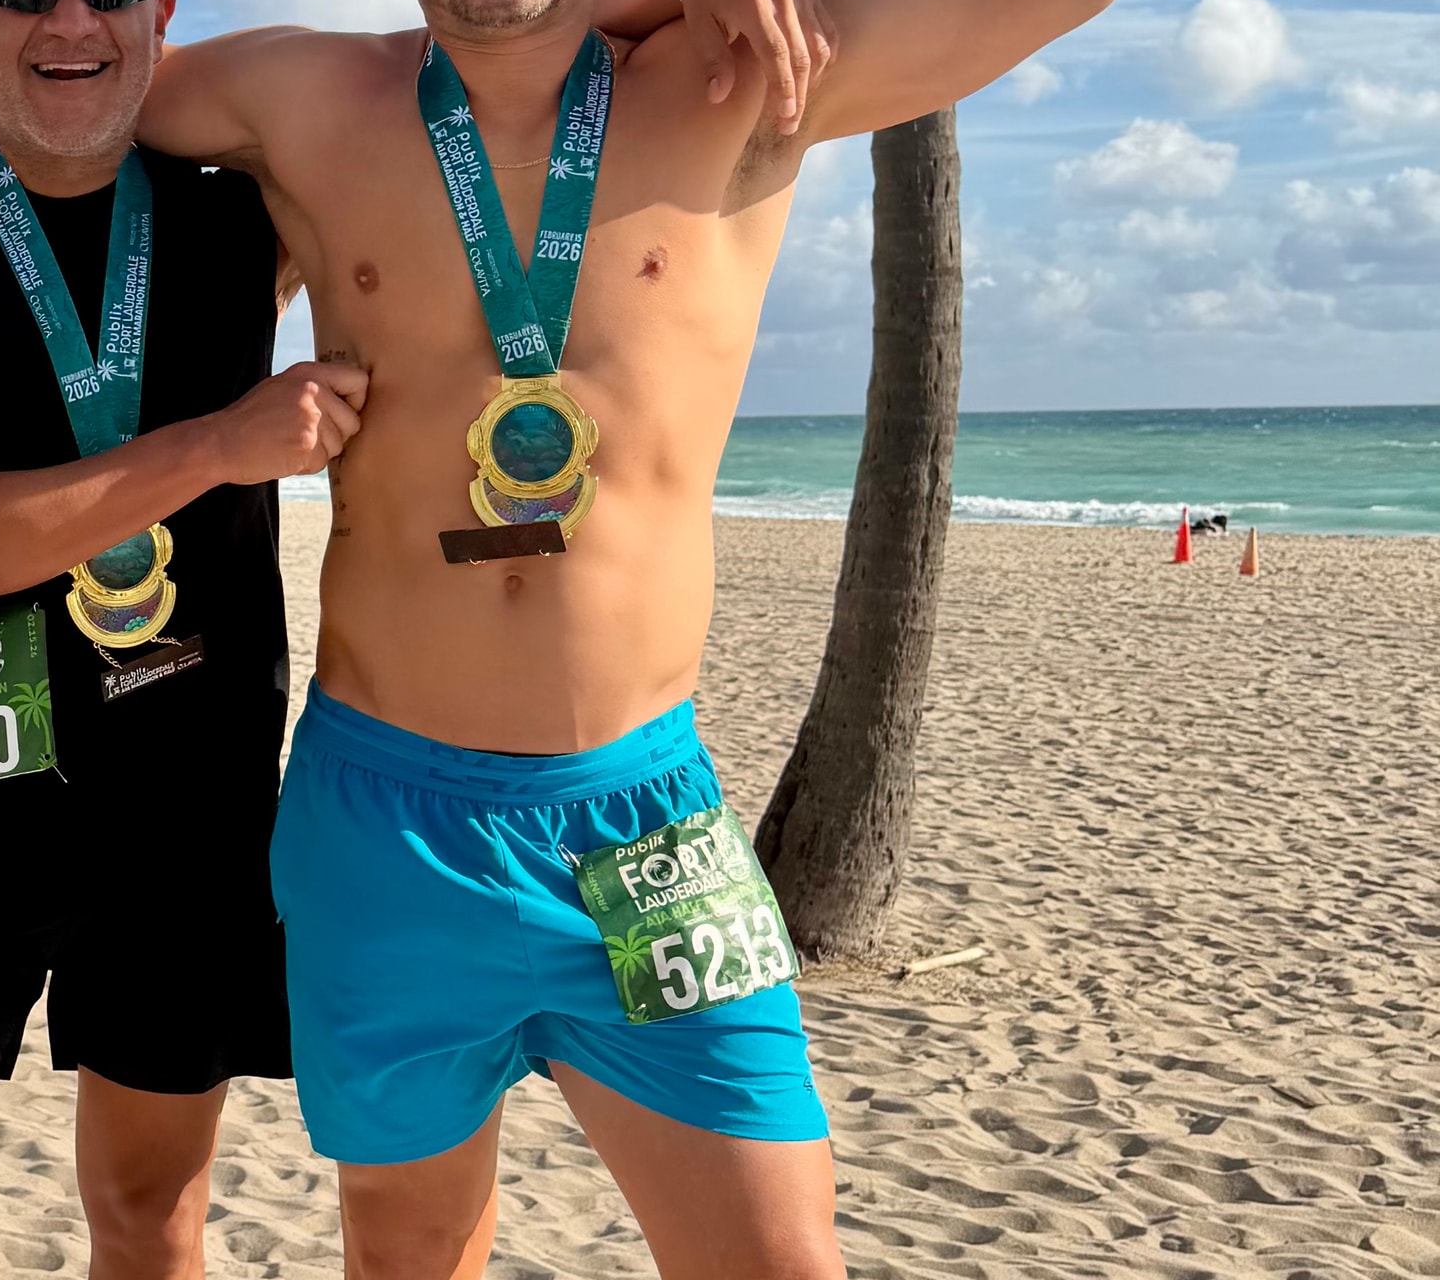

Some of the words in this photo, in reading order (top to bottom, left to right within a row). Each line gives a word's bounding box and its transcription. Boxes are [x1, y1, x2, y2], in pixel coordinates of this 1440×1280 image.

[583, 71, 600, 123] LAUDERDALE
[562, 105, 584, 152] Publix
[577, 124, 594, 153] FORT
[457, 131, 481, 182] Publix
[441, 157, 465, 211] MARATHON
[460, 219, 476, 244] HALF
[444, 138, 465, 164] FORT
[455, 166, 487, 240] LAUDERDALE
[6, 191, 31, 237] Publix
[8, 225, 44, 289] LAUDERDALE
[138, 255, 148, 279] HALF
[469, 247, 491, 297] COLAVITA
[537, 239, 581, 262] 2026
[18, 270, 35, 292] HALF
[122, 255, 139, 322] LAUDERDALE
[29, 294, 53, 339] COLAVITA
[106, 302, 123, 353] Publix
[133, 286, 146, 337] MARATHON
[120, 323, 133, 354] FORT
[501, 333, 545, 363] 2026
[64, 376, 100, 403] 2026
[615, 834, 665, 861] Publix
[618, 835, 718, 899] FORT
[634, 871, 729, 915] LAUDERDALE
[651, 904, 792, 1011] 5213
